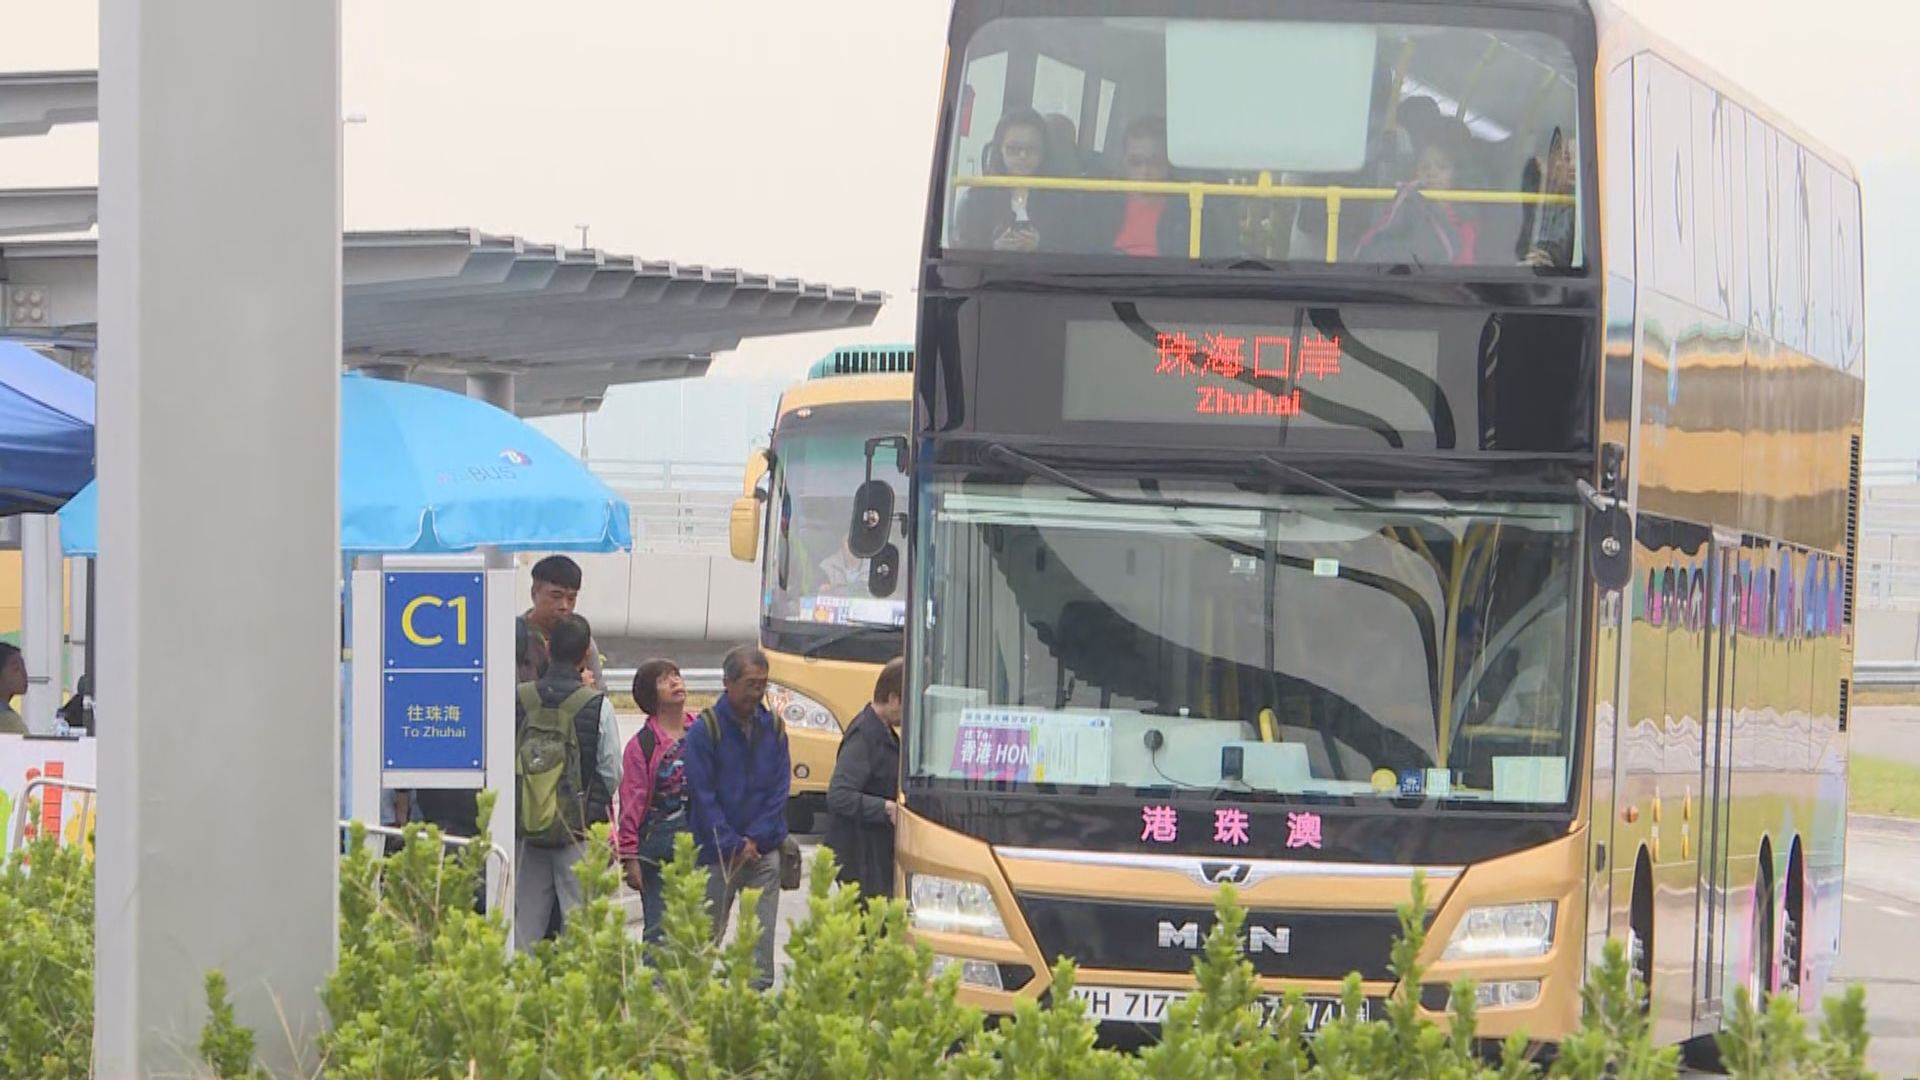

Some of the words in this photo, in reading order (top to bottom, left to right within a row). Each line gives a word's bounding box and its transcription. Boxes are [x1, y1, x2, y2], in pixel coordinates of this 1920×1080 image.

[1156, 332, 1343, 381] 珠海口岸
[1196, 386, 1301, 416] Zhuhai
[402, 595, 467, 645] C1
[407, 704, 460, 722] 往珠海
[403, 726, 419, 737] To
[423, 726, 465, 738] Zhuhai
[961, 739, 992, 764] 香港
[1157, 921, 1290, 953] MN
[1124, 993, 1186, 1017] 717
